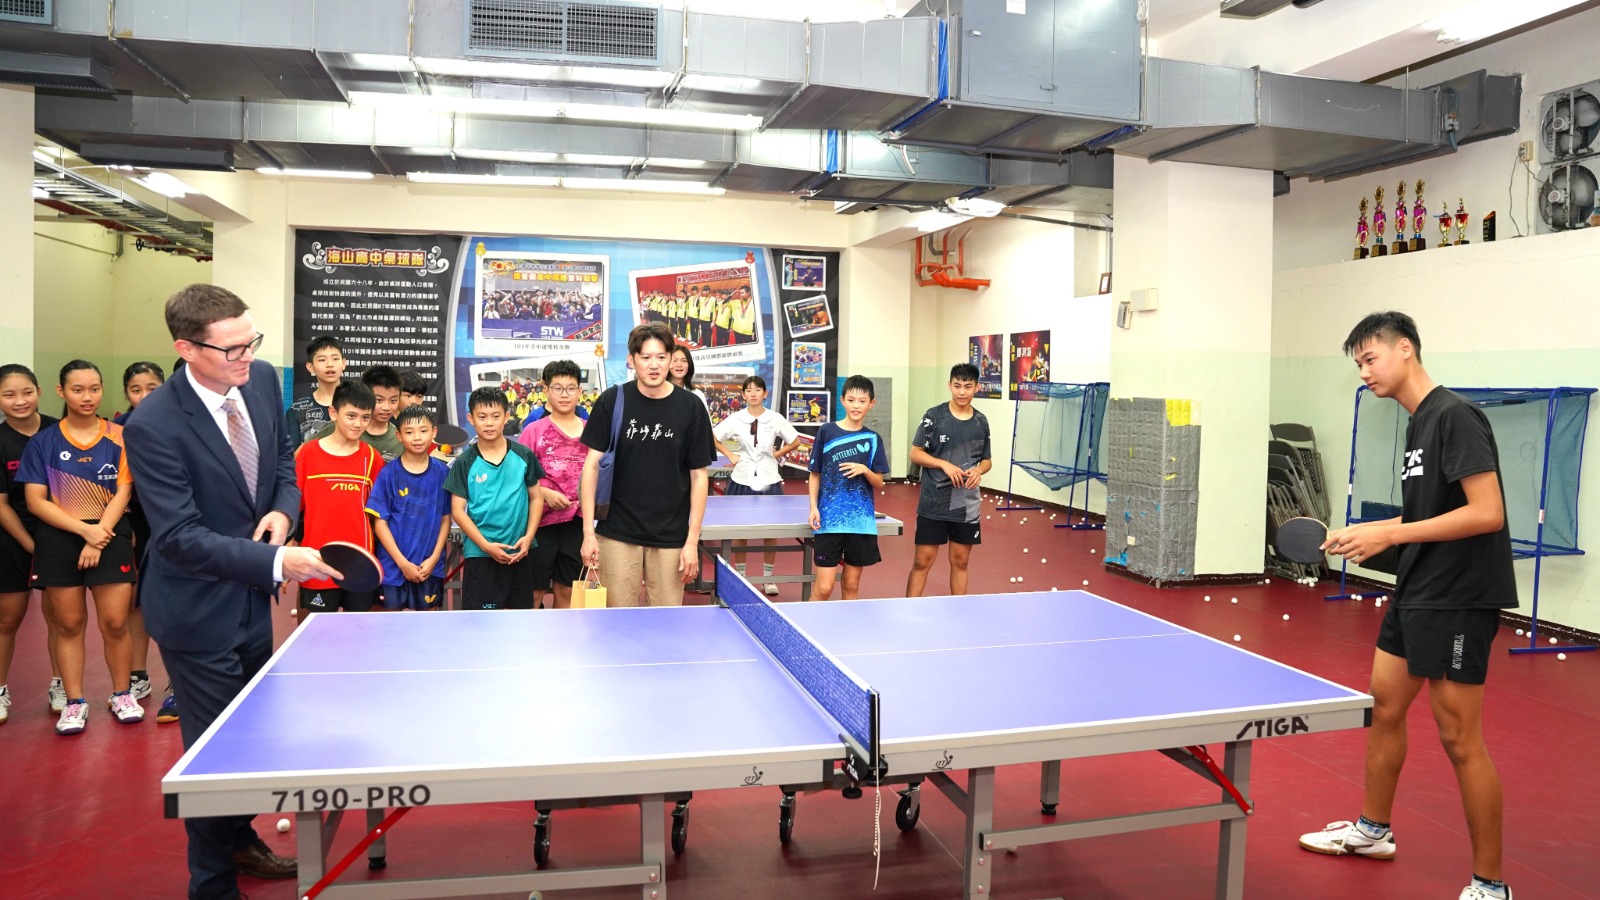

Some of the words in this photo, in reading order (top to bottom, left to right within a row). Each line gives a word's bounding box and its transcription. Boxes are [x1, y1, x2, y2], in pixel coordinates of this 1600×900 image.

[327, 249, 424, 266] 海山高中桌球隊
[540, 326, 563, 336] STW
[832, 448, 858, 462] BUTTERFLY
[331, 483, 360, 492] STIGA
[1236, 716, 1308, 740] STIGA
[271, 784, 431, 813] 7190-PRO
